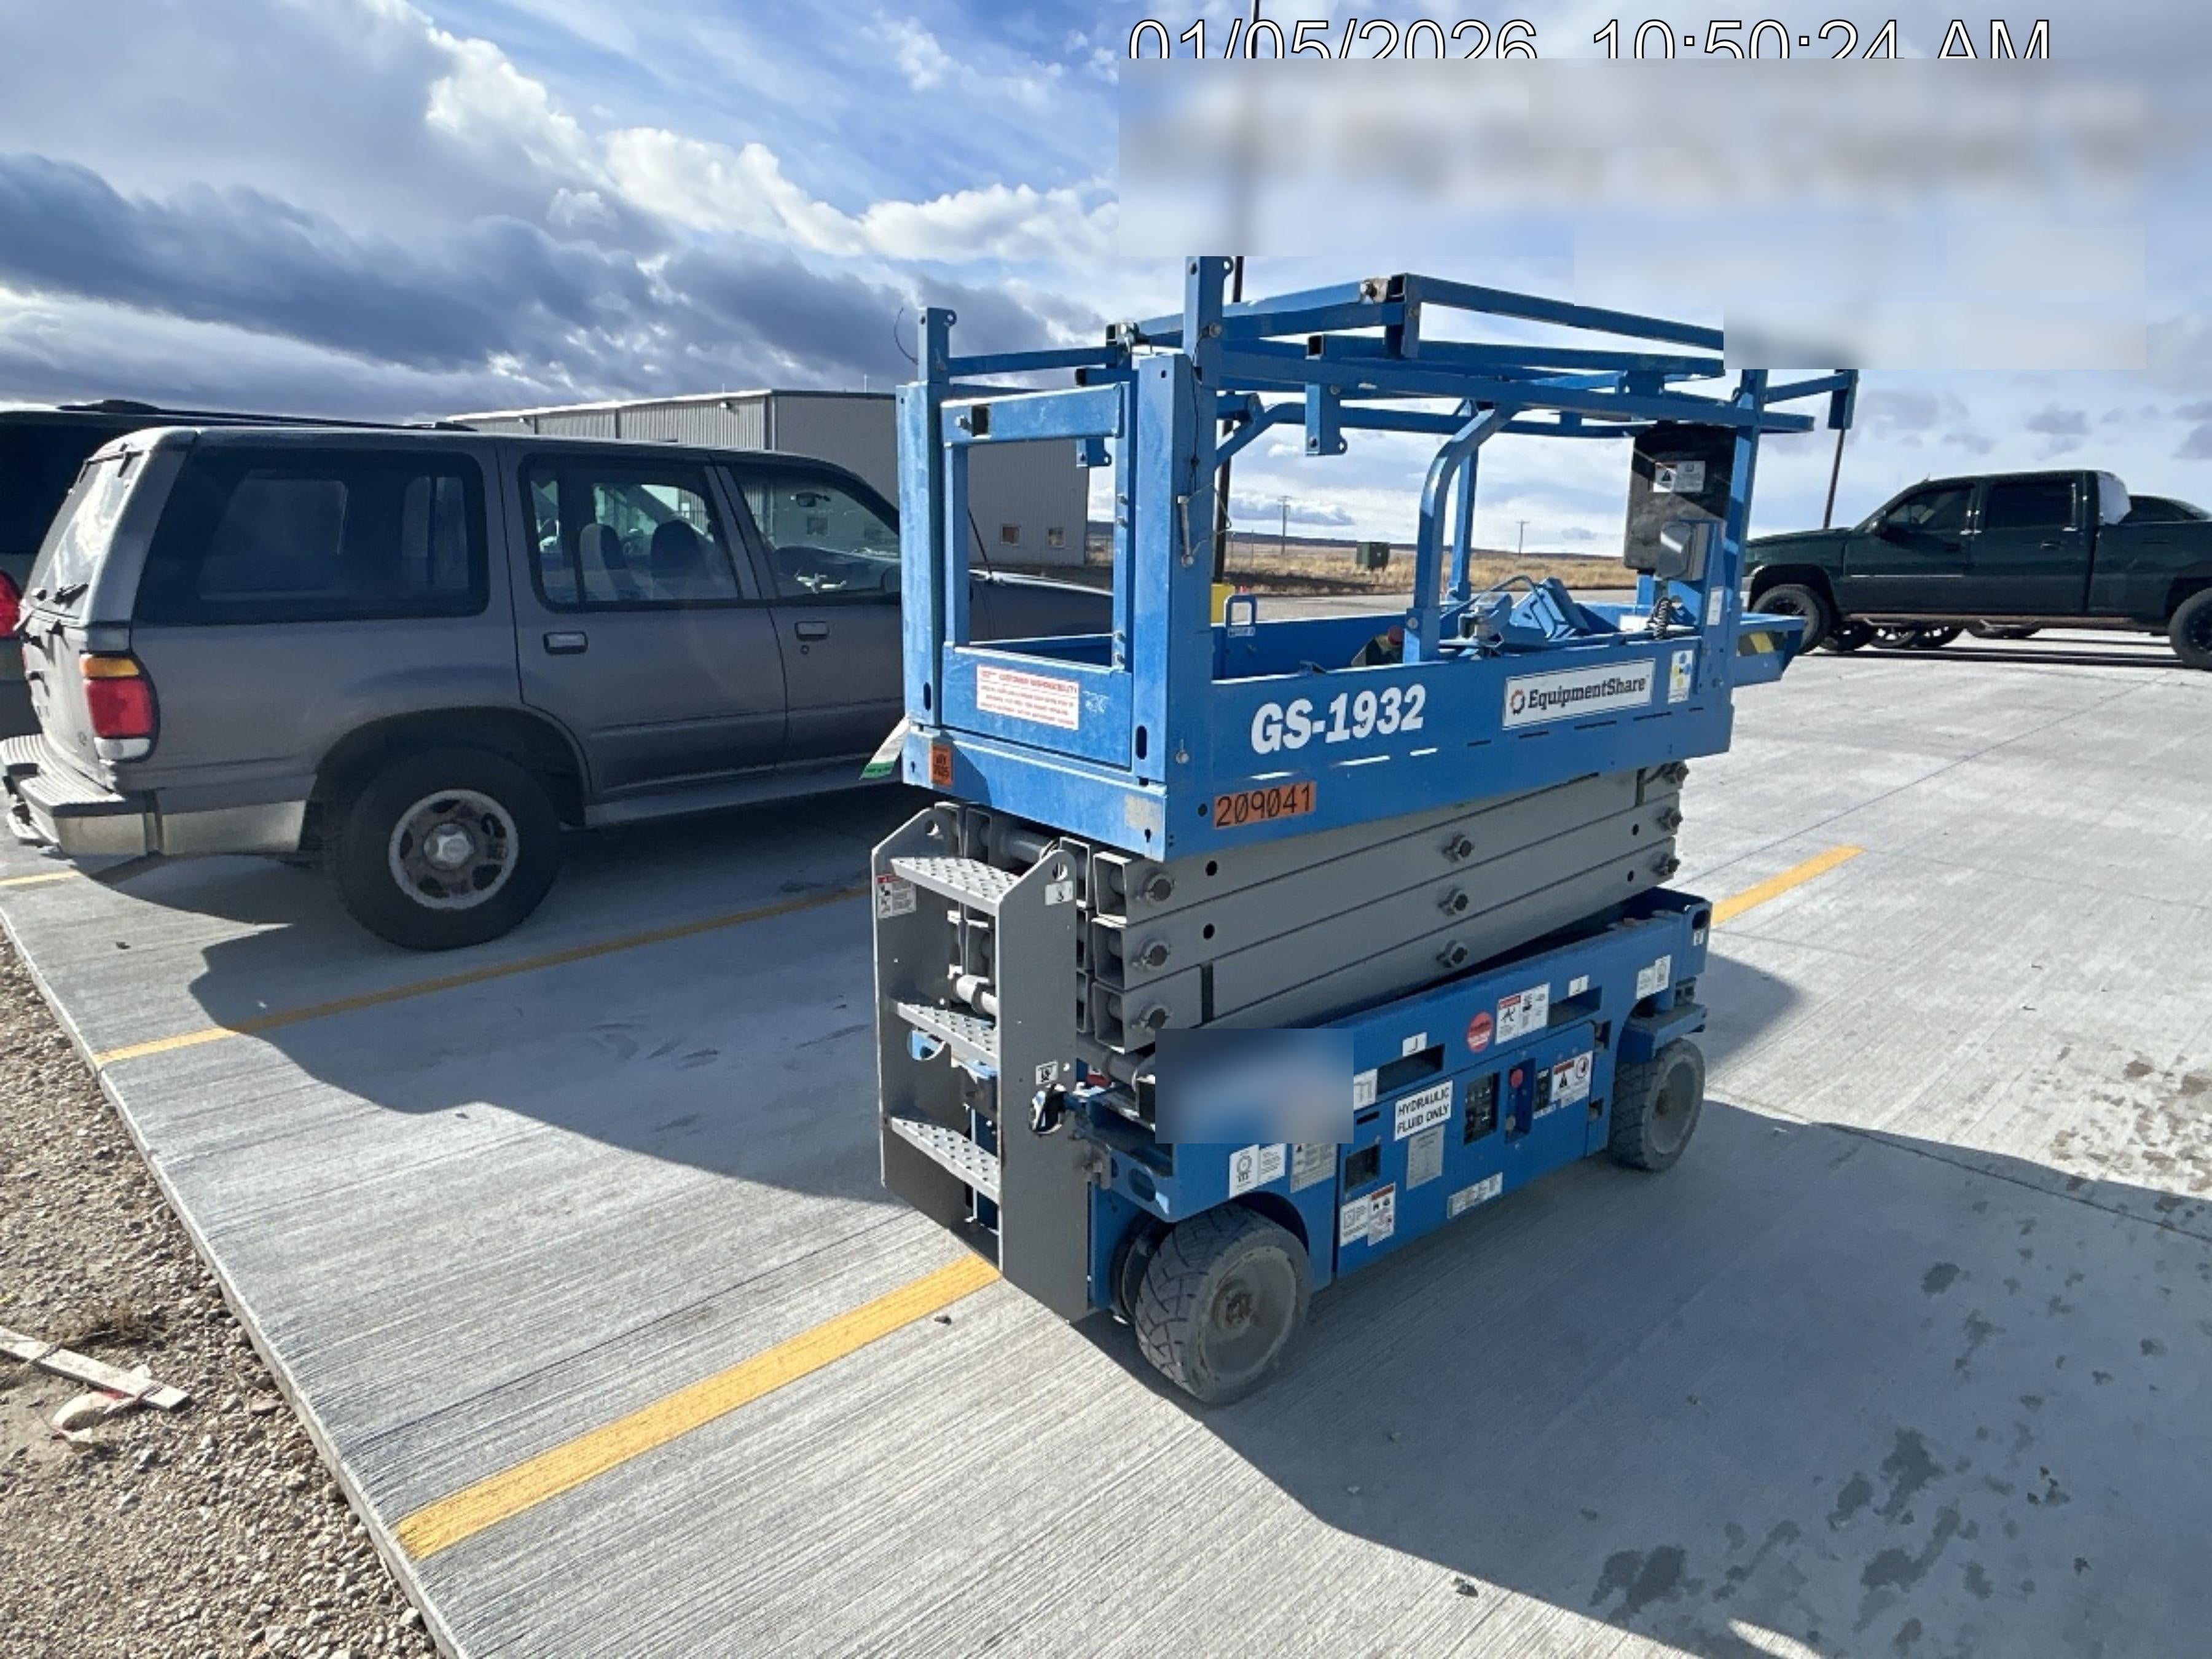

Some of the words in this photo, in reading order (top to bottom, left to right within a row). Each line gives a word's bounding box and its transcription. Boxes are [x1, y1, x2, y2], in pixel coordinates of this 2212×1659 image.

[1528, 677, 1646, 710] EquipmentShare
[1251, 683, 1426, 755] GS-1932
[1216, 783, 1311, 828] 209041
[1397, 1087, 1450, 1118] HYDRAULIC
[1397, 1114, 1424, 1134] FLUID
[1426, 1104, 1449, 1122] ONLY
